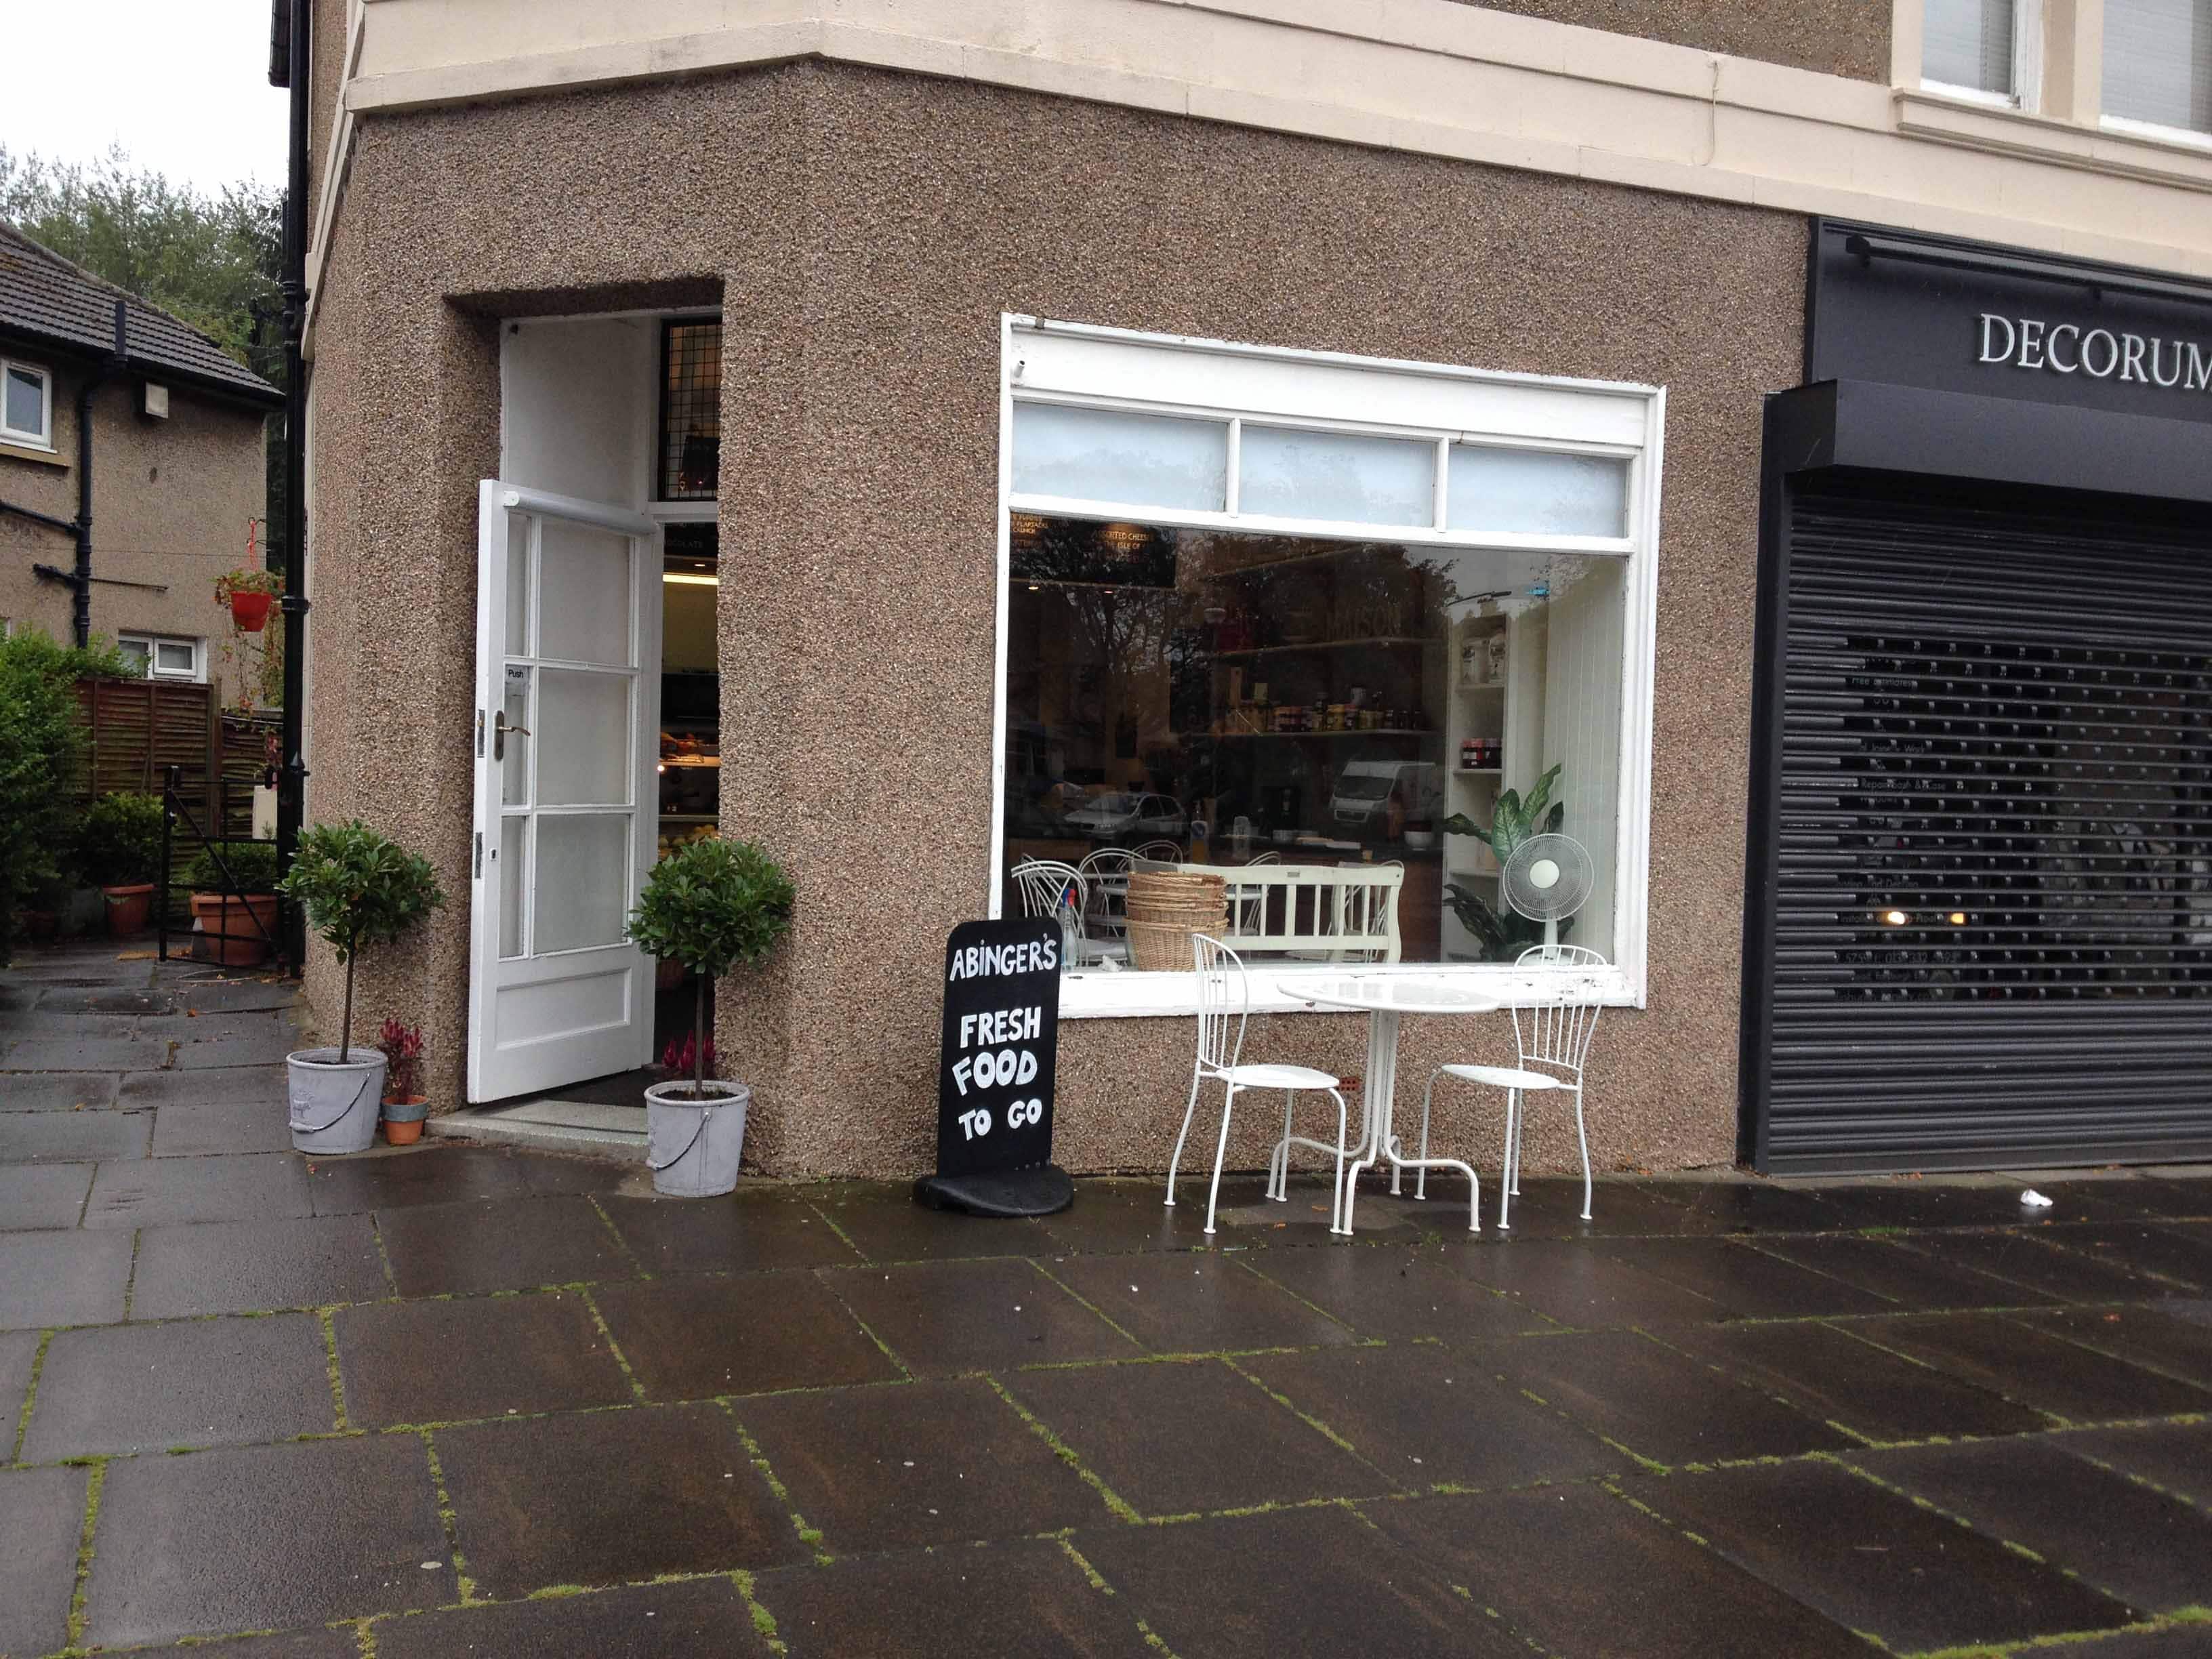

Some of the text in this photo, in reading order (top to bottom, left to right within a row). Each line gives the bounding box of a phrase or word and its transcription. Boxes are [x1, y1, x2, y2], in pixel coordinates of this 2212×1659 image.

[1979, 313, 2212, 391] DECORUM
[508, 669, 524, 678] Push
[960, 1006, 1042, 1048] FRESH
[952, 1049, 1038, 1096] FOOD
[958, 1098, 1042, 1141] TO GO
